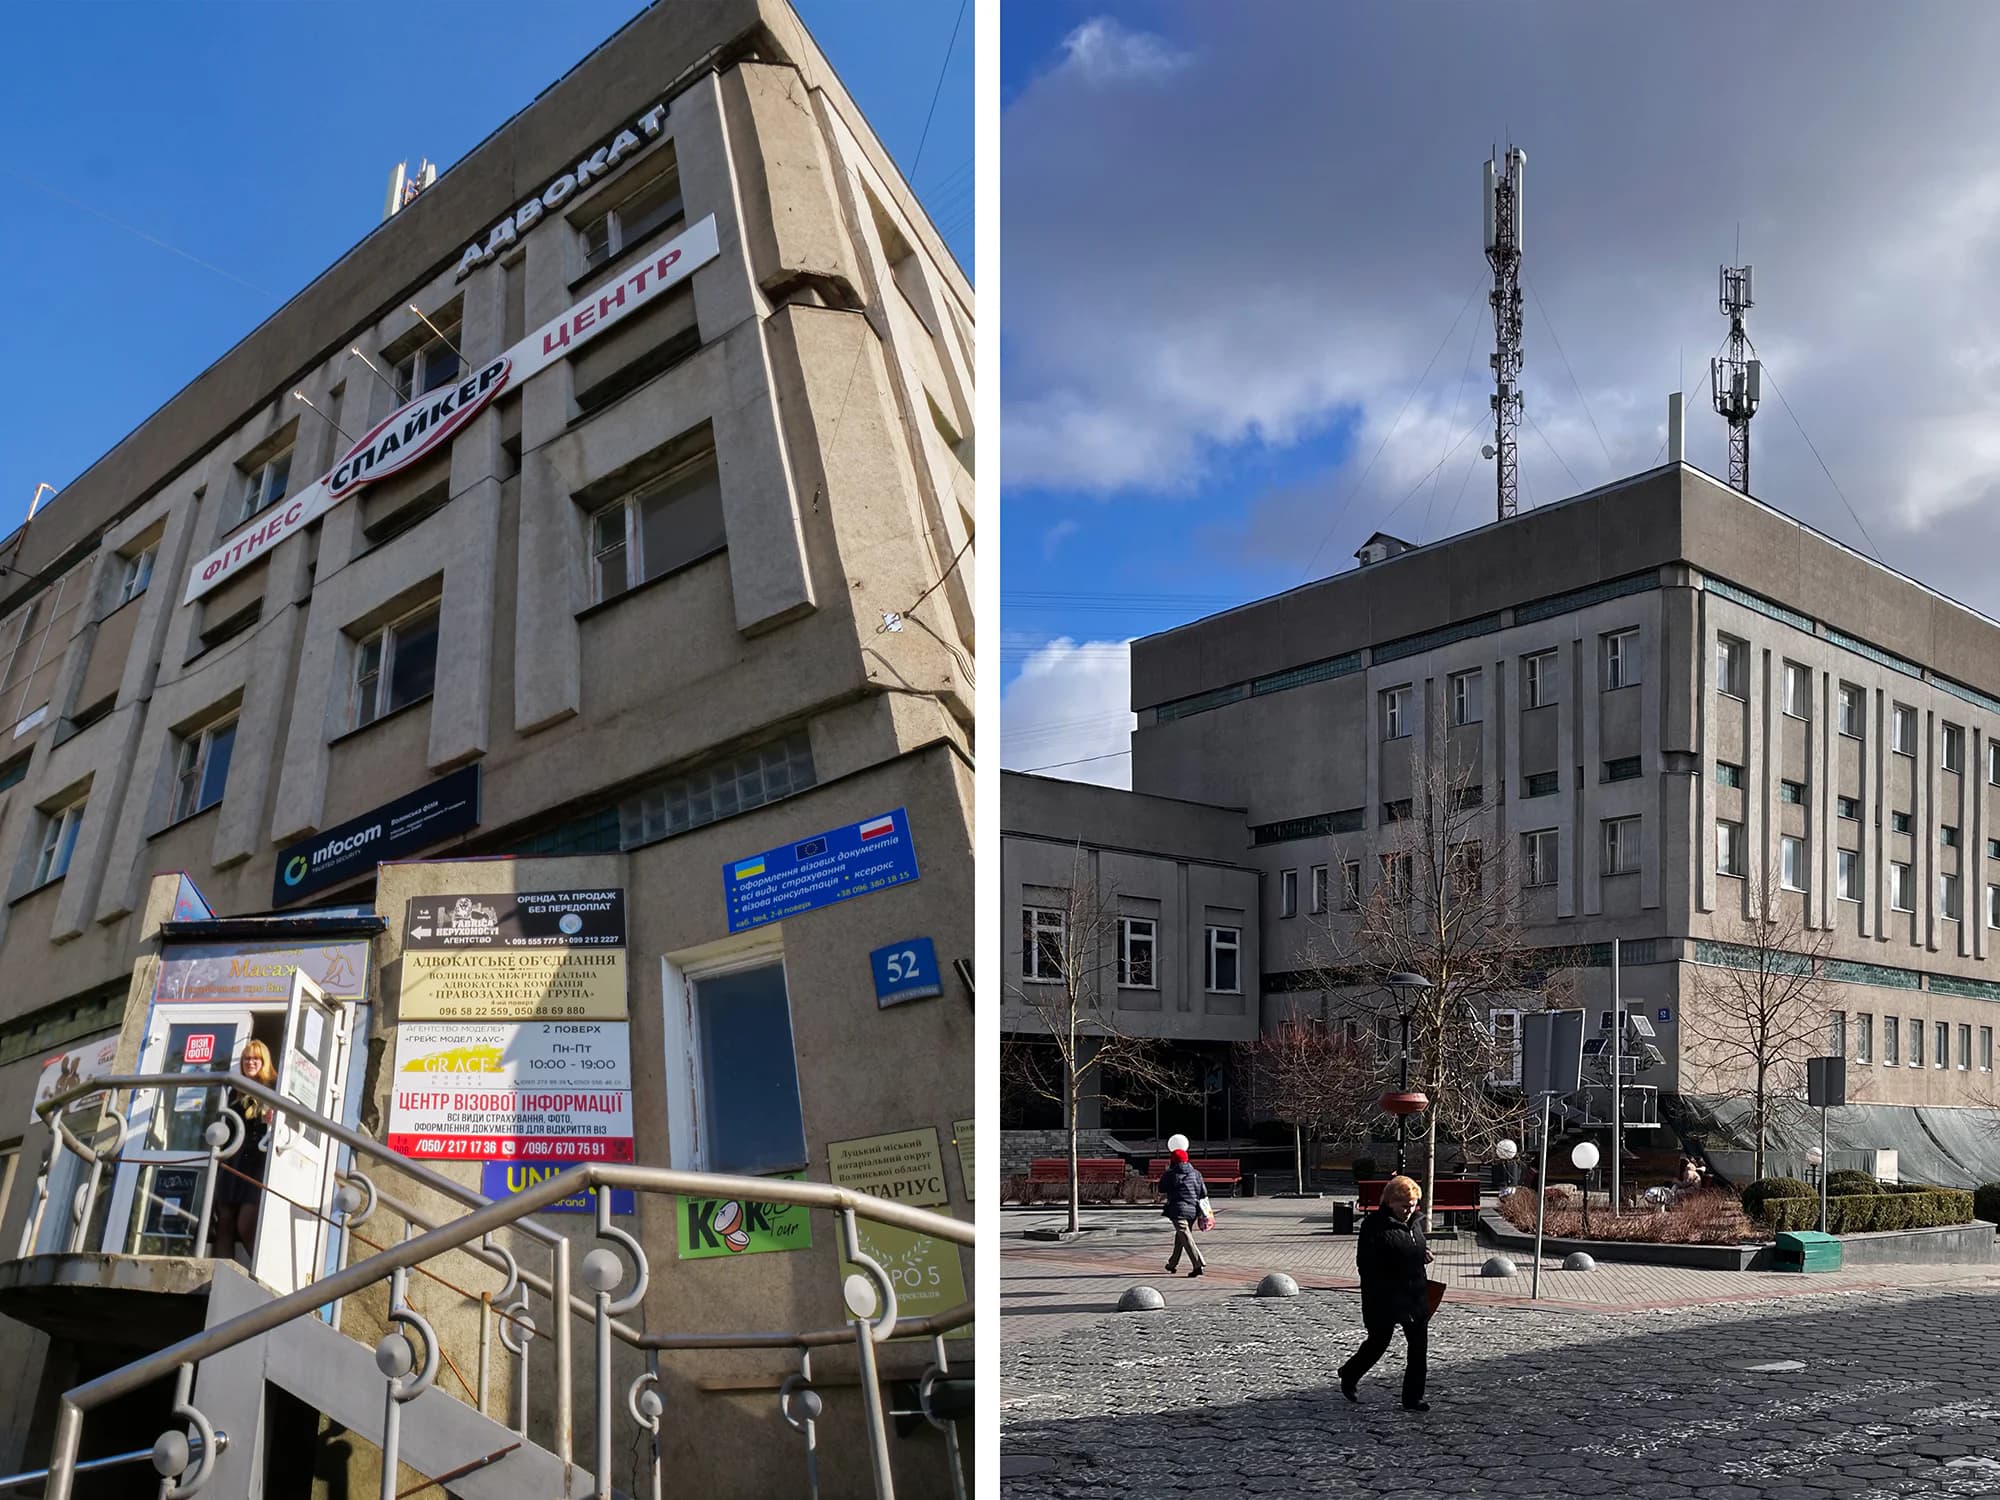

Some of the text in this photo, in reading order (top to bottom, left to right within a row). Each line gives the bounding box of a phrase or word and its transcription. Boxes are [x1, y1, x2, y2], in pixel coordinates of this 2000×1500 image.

[456, 104, 666, 279] АДВОКАТ
[202, 249, 682, 580] ФІТНЕС СПАЙКЕР ЦЕНТР
[313, 824, 382, 865] infocom
[740, 836, 899, 891] оформлення візових документів
[854, 861, 895, 879] ксерокс
[741, 863, 846, 902] всі види страхування
[887, 875, 898, 884] 18
[900, 871, 910, 880] 15
[517, 892, 616, 904] ОРЕНДА ТА ПРОДАЖ
[742, 876, 839, 912] візова консультація
[528, 903, 611, 914] БЕЗ ПЕРЕДОПЛАТ
[436, 927, 499, 937] НЕРУХОМОСТІ
[444, 936, 492, 945] АГЕНТСТВО
[600, 935, 619, 943] 2227
[229, 959, 298, 977] Масаж
[413, 955, 616, 969] АДВОКАТСЬКЕ ОБ’ЄДНАННЯ
[887, 950, 920, 983] 52
[429, 971, 597, 980] ВОЛИНСЬКА МІЖРЕГІОНАЛЬНА
[443, 980, 584, 989] АДВОКАТСЬКА КОМПАНІЯ
[439, 1007, 457, 1016] 096
[461, 1007, 472, 1016] 58
[475, 1007, 487, 1016] 22
[514, 1006, 533, 1015] 050
[536, 1006, 548, 1015] 88
[551, 1006, 564, 1015] 69
[566, 1006, 585, 1015] 880
[406, 1025, 505, 1033] АГЕНТСТВО МОДЕЛЕЙ
[543, 1024, 601, 1034] 2 ПОВЕРХ
[191, 1038, 208, 1048] ВІЗИ
[552, 1044, 592, 1054] Пн-Пт
[188, 1047, 210, 1058] ФОТО
[529, 1059, 567, 1070] 10:00
[581, 1059, 616, 1070] 19:00
[399, 1091, 623, 1114] ЦЕНТР ВІЗОВОЇ ІНФОРМАЦІЇ
[447, 1113, 460, 1122] ВСІ
[462, 1113, 484, 1123] ВИДИ
[485, 1113, 546, 1124] СТРАХУВАННЯ,
[414, 1122, 607, 1134] ОФОРМЛЕННЯ ДОКУМЕНТІВ ДЛЯ ВІДКРИТТЯ ВІЗ
[415, 1139, 447, 1153] /050/
[448, 1140, 467, 1153] 217
[470, 1141, 481, 1153] 17
[484, 1141, 497, 1153] 36
[522, 1142, 554, 1155] /096/
[556, 1142, 575, 1155] 670
[578, 1143, 590, 1155] 75
[592, 1143, 605, 1155] 91
[841, 1140, 922, 1160] Луцький міський
[837, 1151, 932, 1170] нотаріальний округ
[839, 1162, 931, 1182] Волинської області
[768, 1216, 800, 1237] Tour
[927, 1266, 940, 1285] 5
